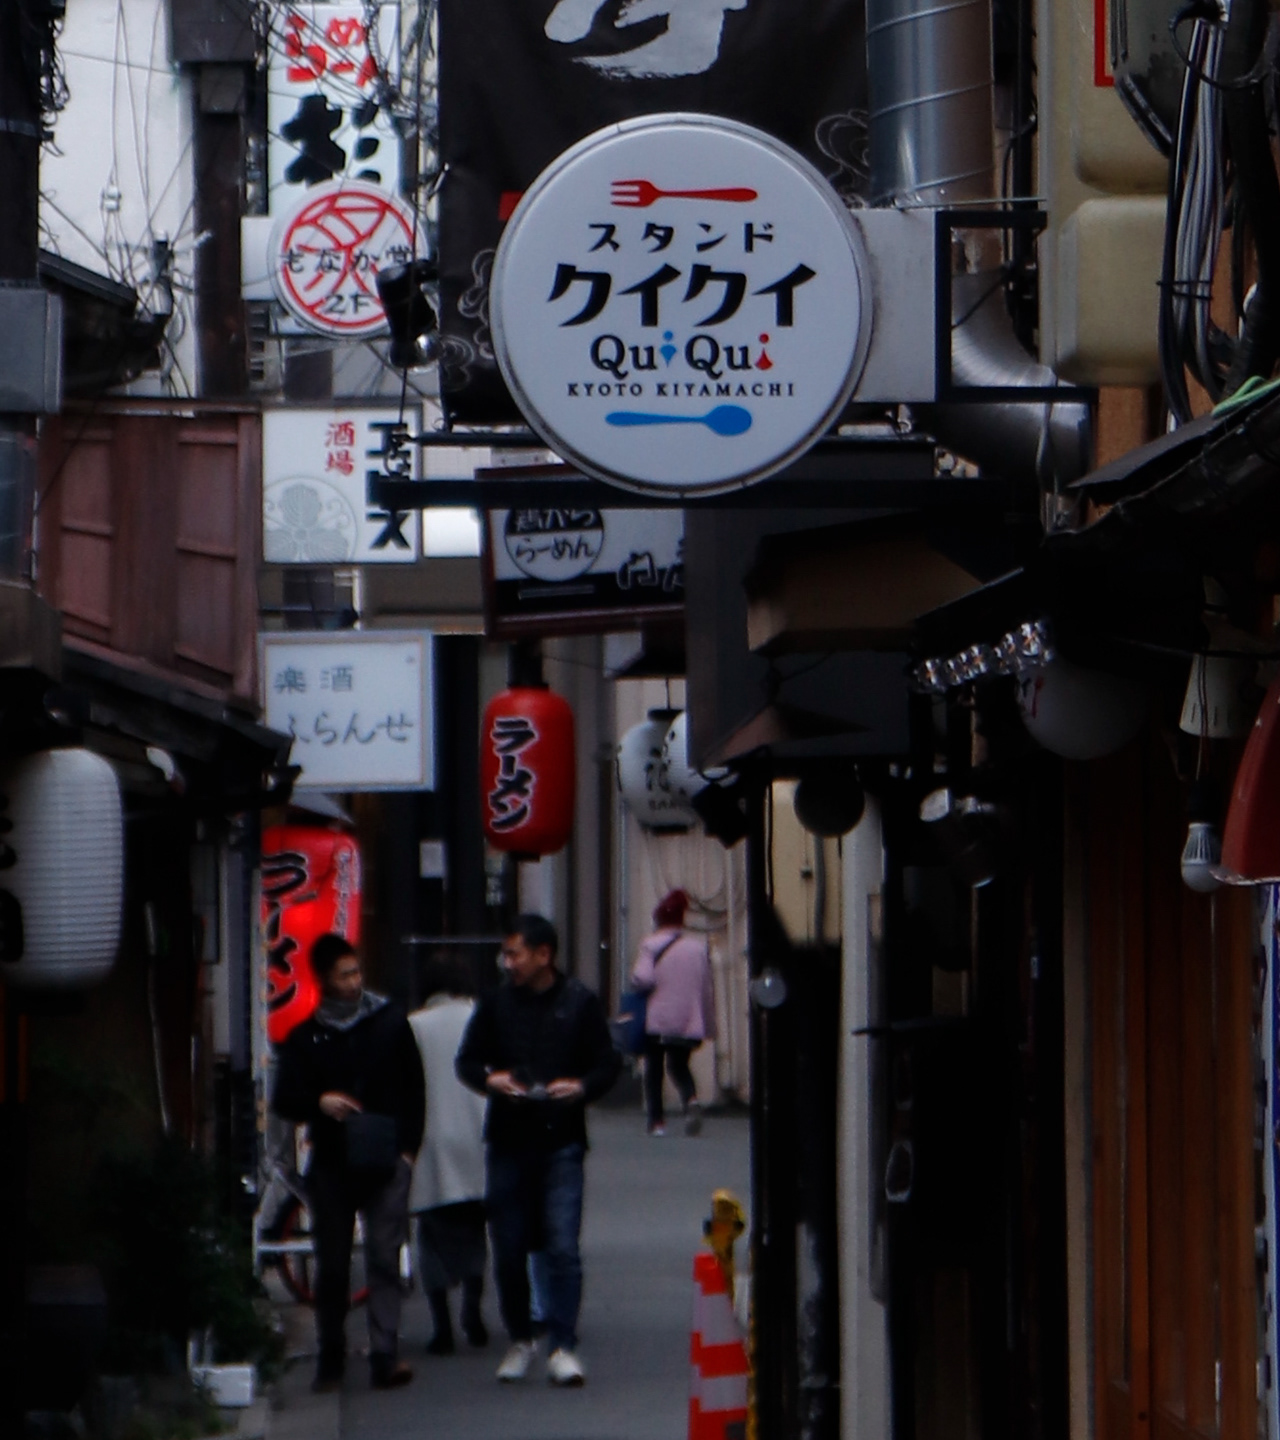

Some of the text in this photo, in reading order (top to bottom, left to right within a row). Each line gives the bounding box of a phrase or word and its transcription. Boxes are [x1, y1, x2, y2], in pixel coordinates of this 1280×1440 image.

[588, 222, 773, 253] スタンド
[324, 293, 371, 315] 2F
[547, 263, 816, 327] クイクイ
[568, 383, 795, 397] KYOTO KIYAMACHI
[325, 421, 355, 476] 酒場
[515, 537, 595, 564] らーめん
[488, 716, 540, 834] ラーメン
